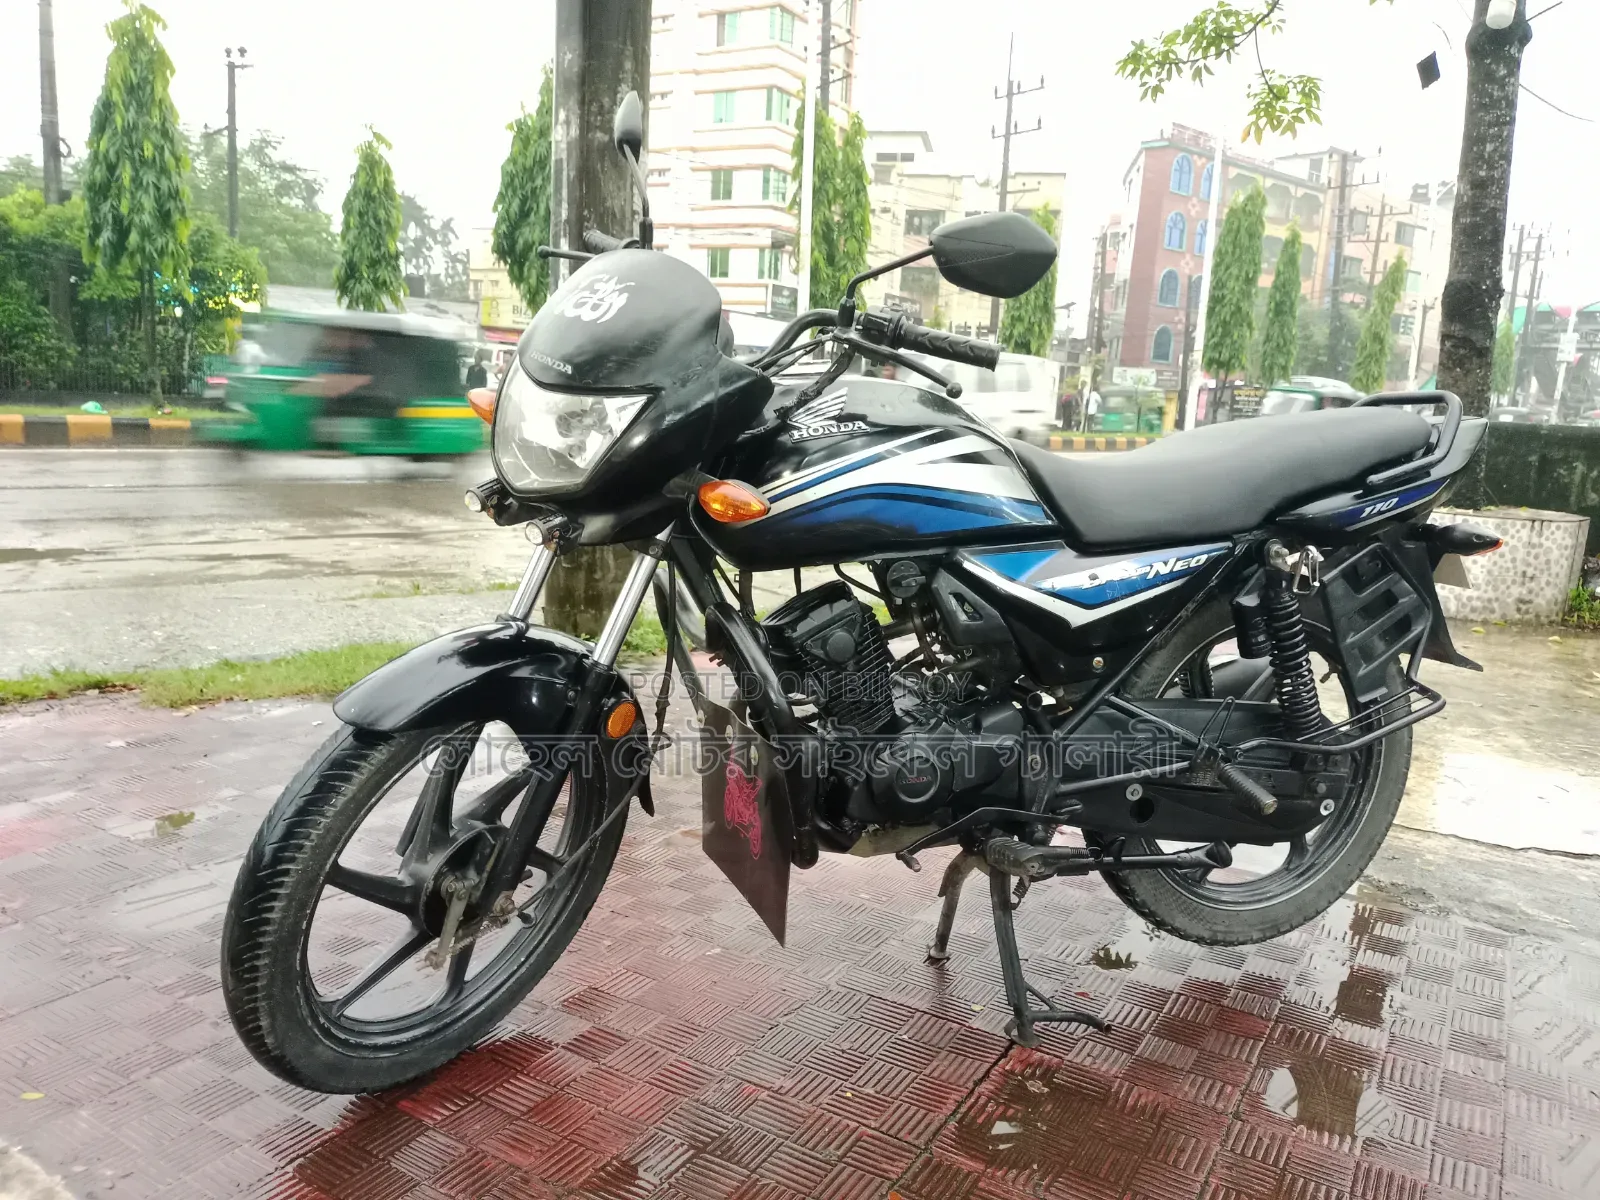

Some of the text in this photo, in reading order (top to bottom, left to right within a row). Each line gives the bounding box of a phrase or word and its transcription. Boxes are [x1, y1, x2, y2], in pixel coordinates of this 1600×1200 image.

[530, 350, 572, 375] HONDA
[791, 421, 869, 440] HONDA
[1360, 498, 1399, 518] 110
